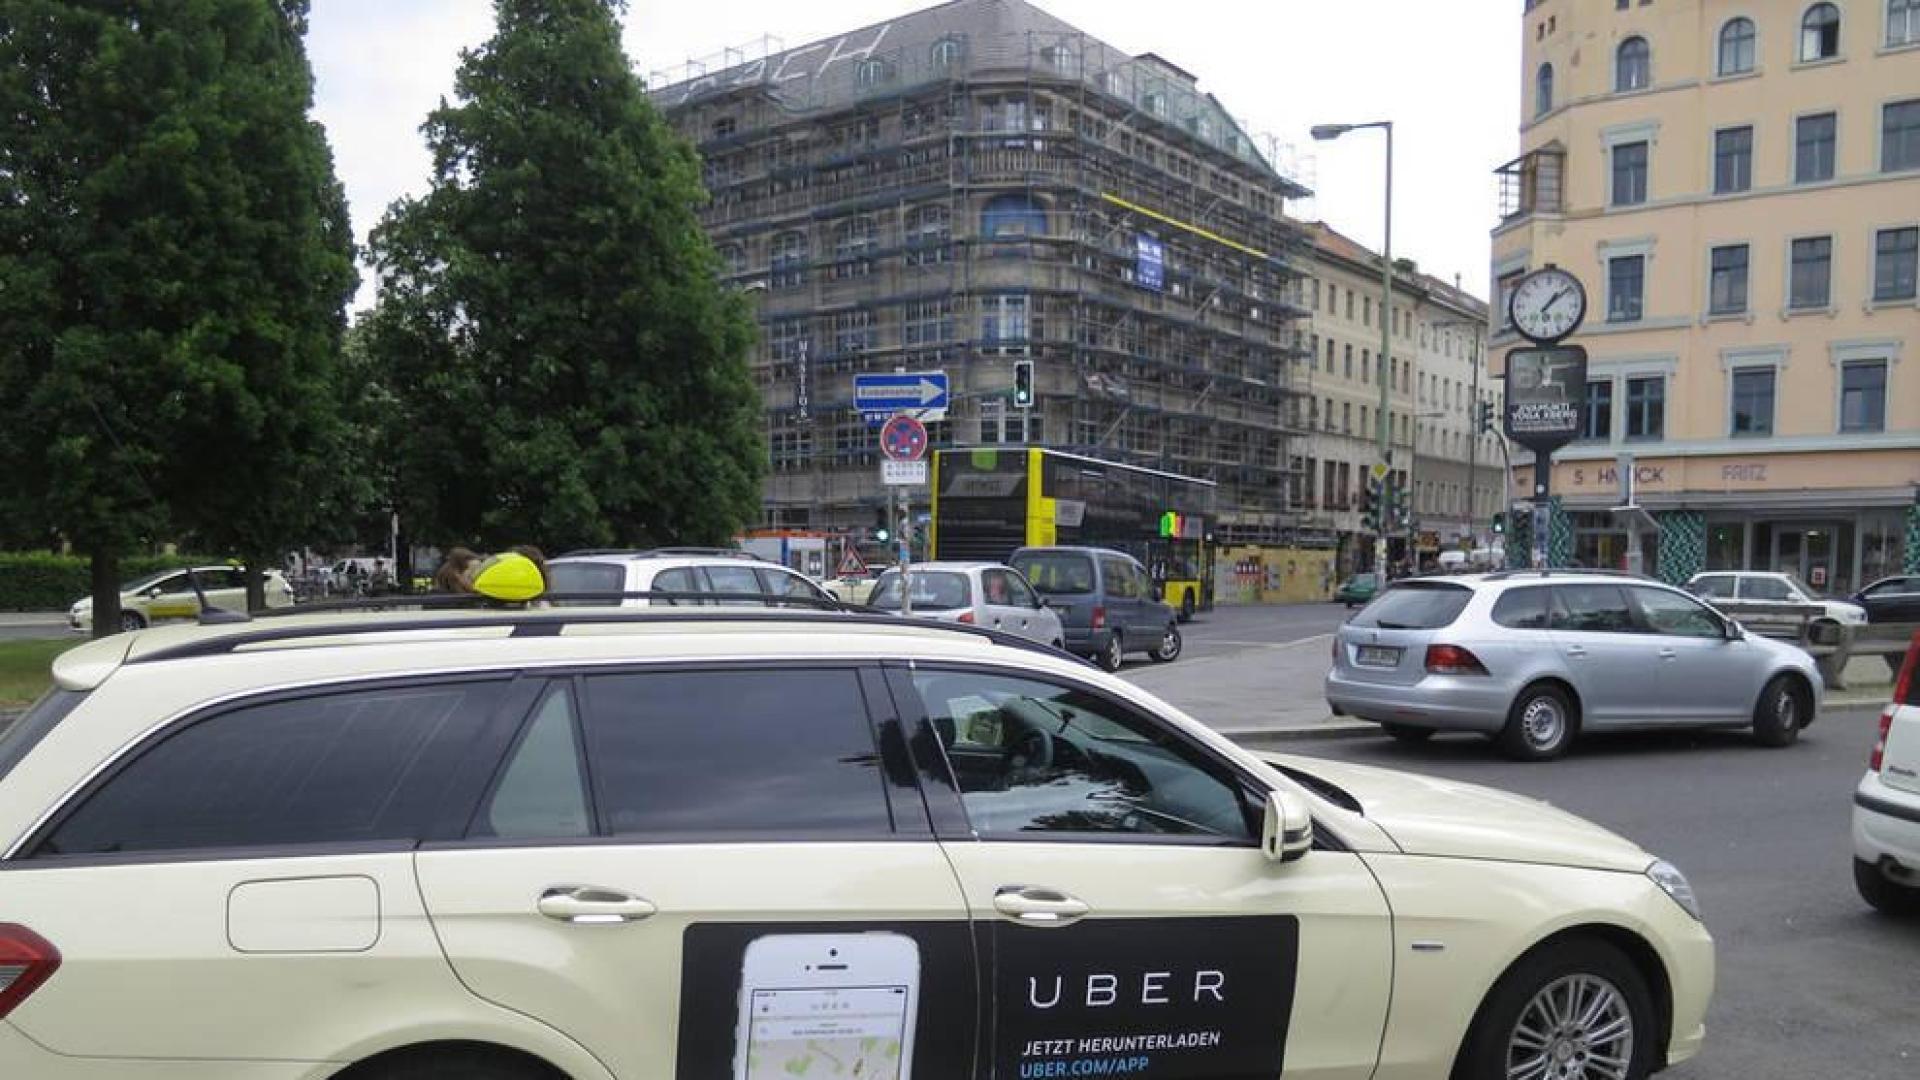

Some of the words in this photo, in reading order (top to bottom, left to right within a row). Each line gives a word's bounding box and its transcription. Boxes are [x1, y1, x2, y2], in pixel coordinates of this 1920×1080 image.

[1721, 464, 1768, 482] FRITZ
[1029, 970, 1225, 1009] UBER
[1022, 1039, 1074, 1056] JETZT
[1078, 1031, 1221, 1053] HERUNTERLADEN
[1020, 1056, 1149, 1079] UBER.COM/APP
